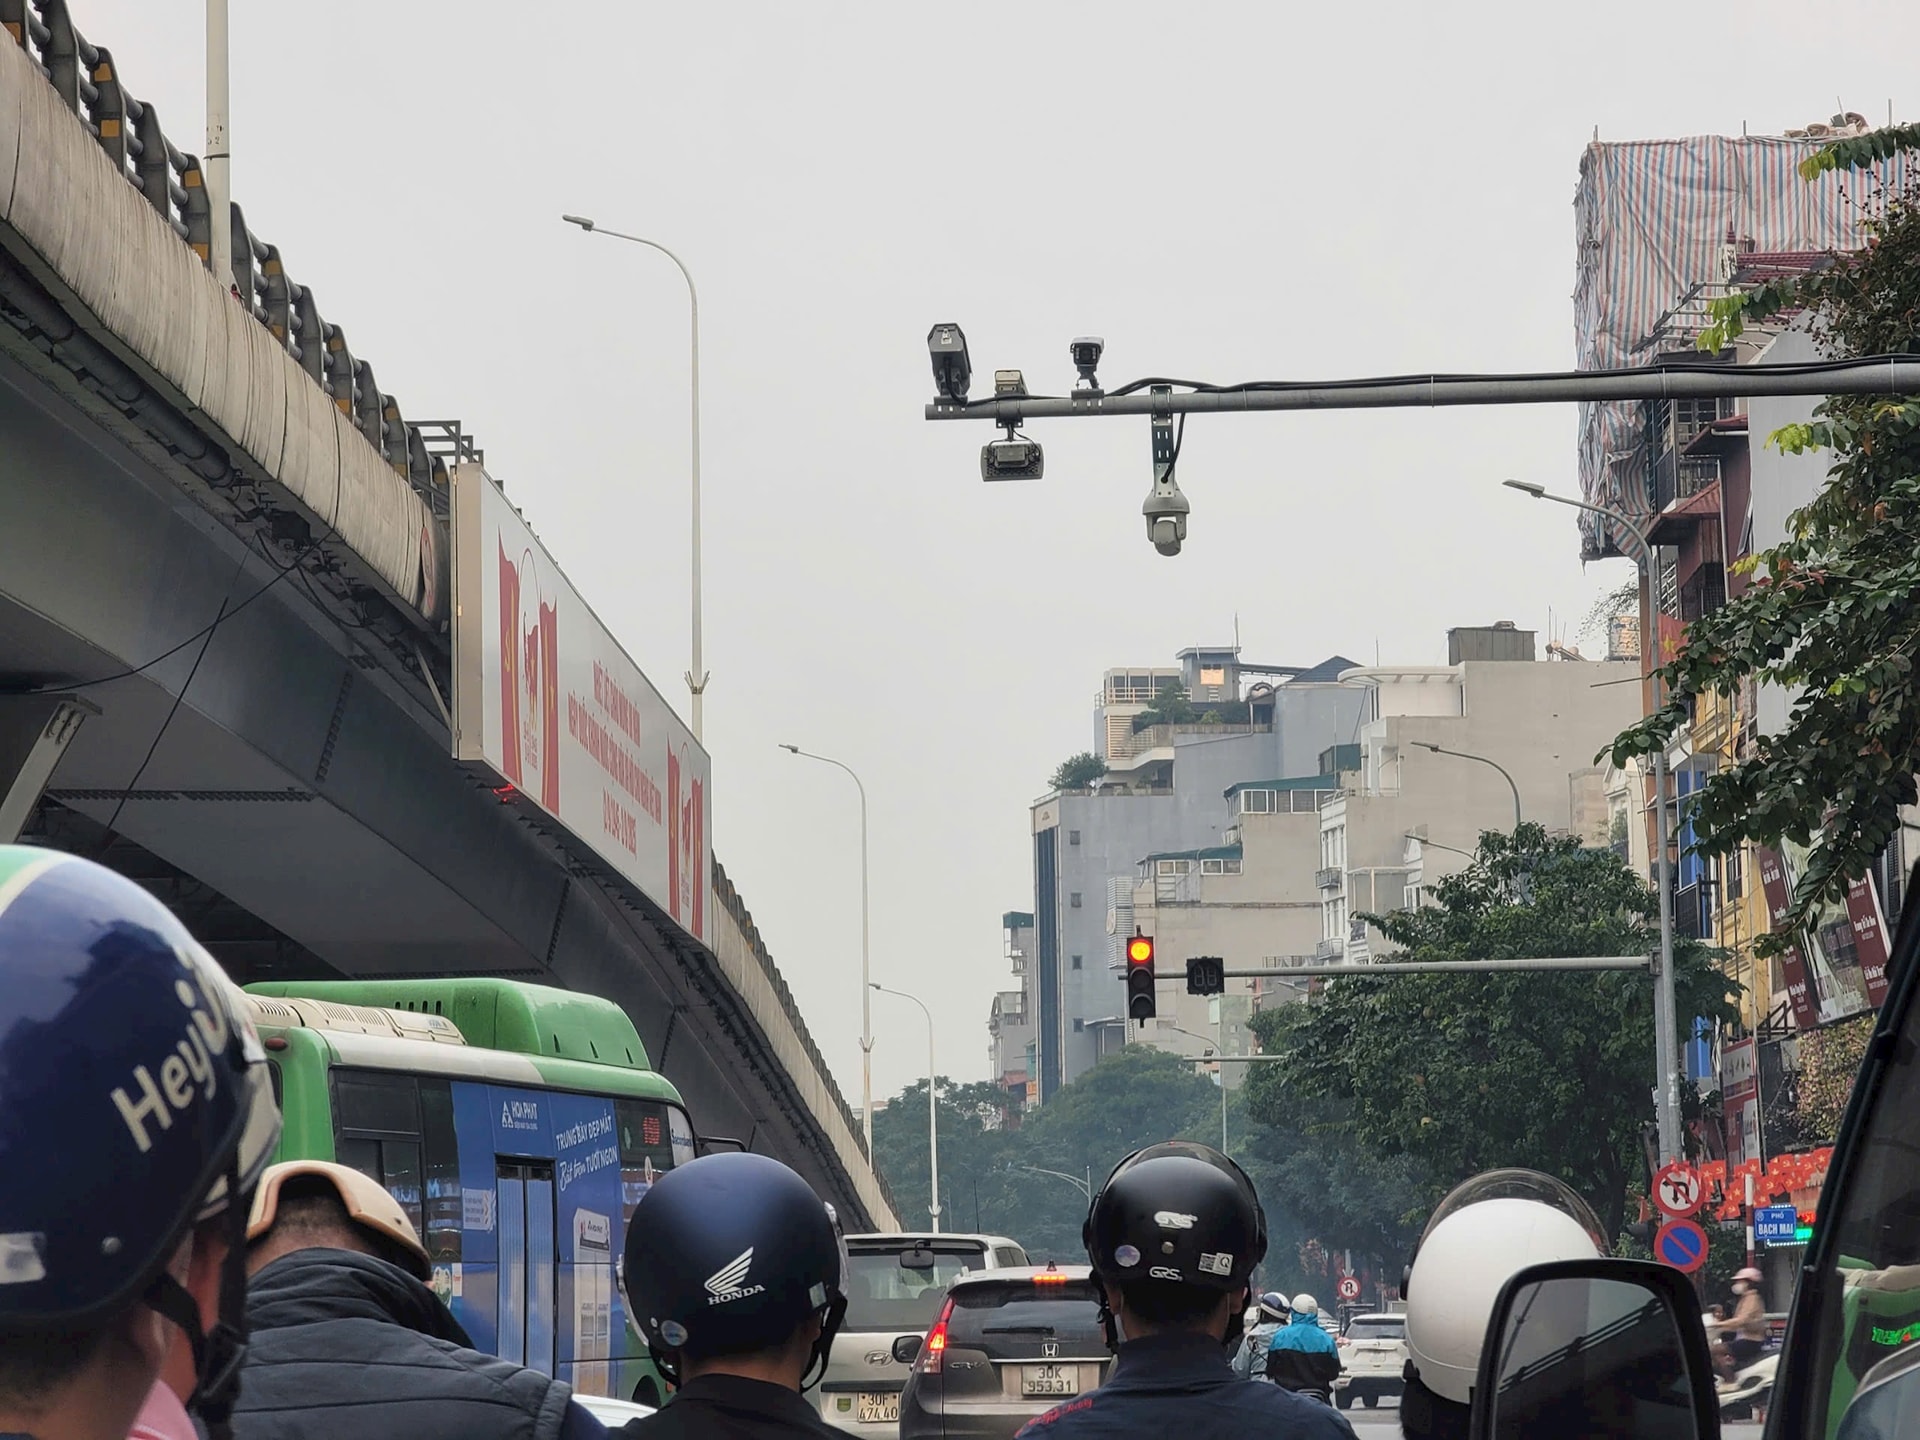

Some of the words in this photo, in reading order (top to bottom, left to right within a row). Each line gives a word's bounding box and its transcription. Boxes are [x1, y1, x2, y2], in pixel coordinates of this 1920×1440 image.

[1758, 1223, 1778, 1237] BẠCH
[1779, 1223, 1794, 1234] MAI
[707, 1284, 766, 1306] HONDA
[1038, 1367, 1062, 1380] 30K
[1028, 1380, 1072, 1393] 953.31
